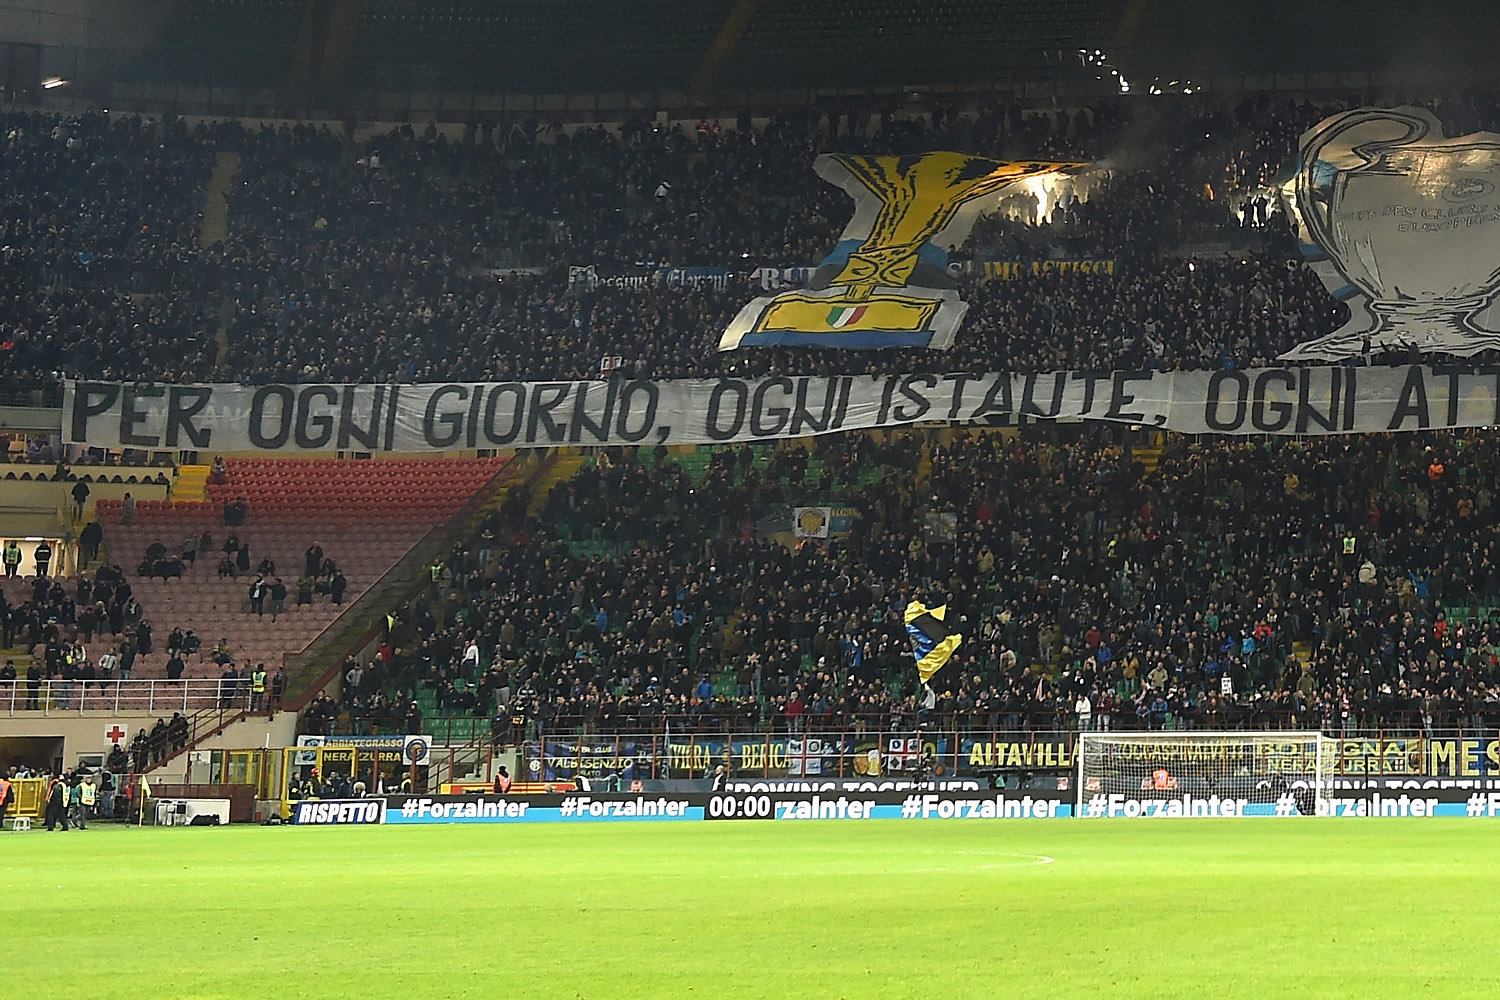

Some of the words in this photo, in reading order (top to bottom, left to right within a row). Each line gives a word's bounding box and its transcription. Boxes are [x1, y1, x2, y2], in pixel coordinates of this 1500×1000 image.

[72, 381, 211, 449] PER
[249, 384, 398, 451] OGNI
[425, 380, 670, 447] GIORNO,
[706, 375, 853, 441] OGNI
[875, 370, 1167, 427] ISTANTE,
[1205, 367, 1356, 432] OGNI
[1258, 741, 1405, 757] BOLOGNA
[299, 801, 379, 824] RISPETTO
[401, 798, 529, 819] #ForzaInter
[560, 796, 688, 817] #ForzaInter
[709, 795, 771, 817] 00:00
[901, 794, 1062, 819] #ForzaInter
[1087, 793, 1249, 818] #ForzaInter
[1274, 792, 1438, 817] #orzaInter
